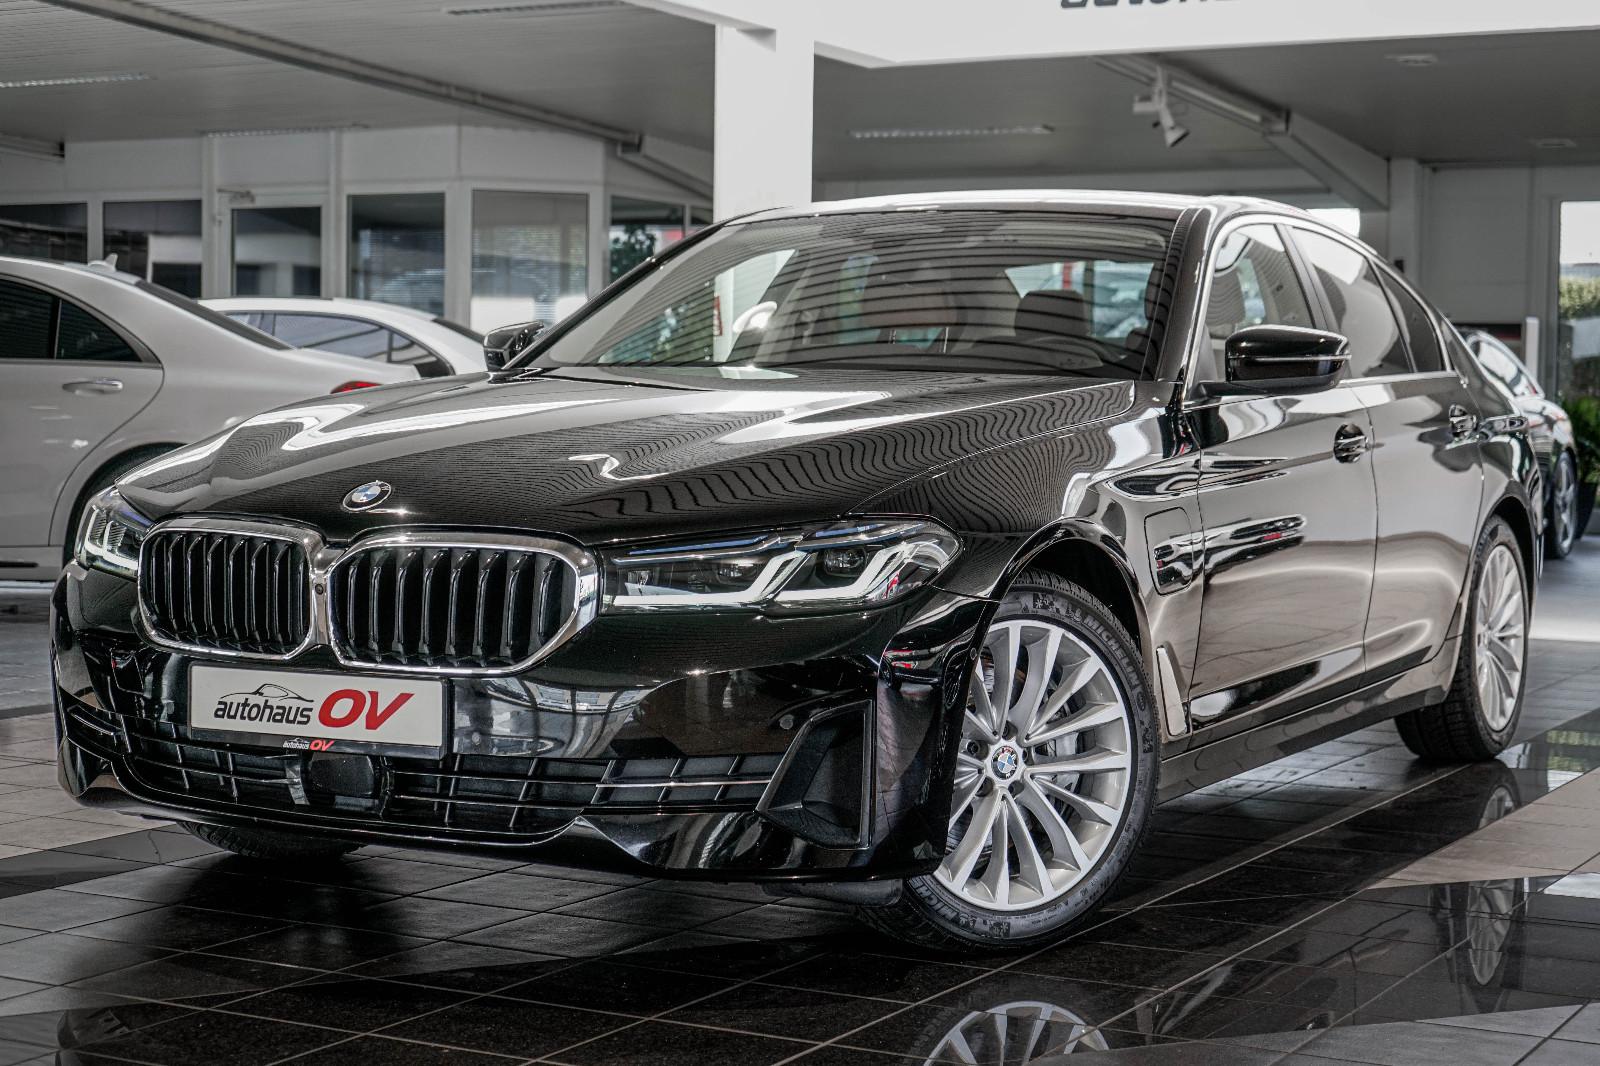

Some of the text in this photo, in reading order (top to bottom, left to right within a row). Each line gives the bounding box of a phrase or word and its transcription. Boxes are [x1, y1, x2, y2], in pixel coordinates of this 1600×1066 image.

[1083, 614, 1140, 687] MICHELIN
[214, 688, 415, 731] autohaus OV
[283, 739, 335, 751] autohaus OV
[910, 876, 958, 920] MICHE
